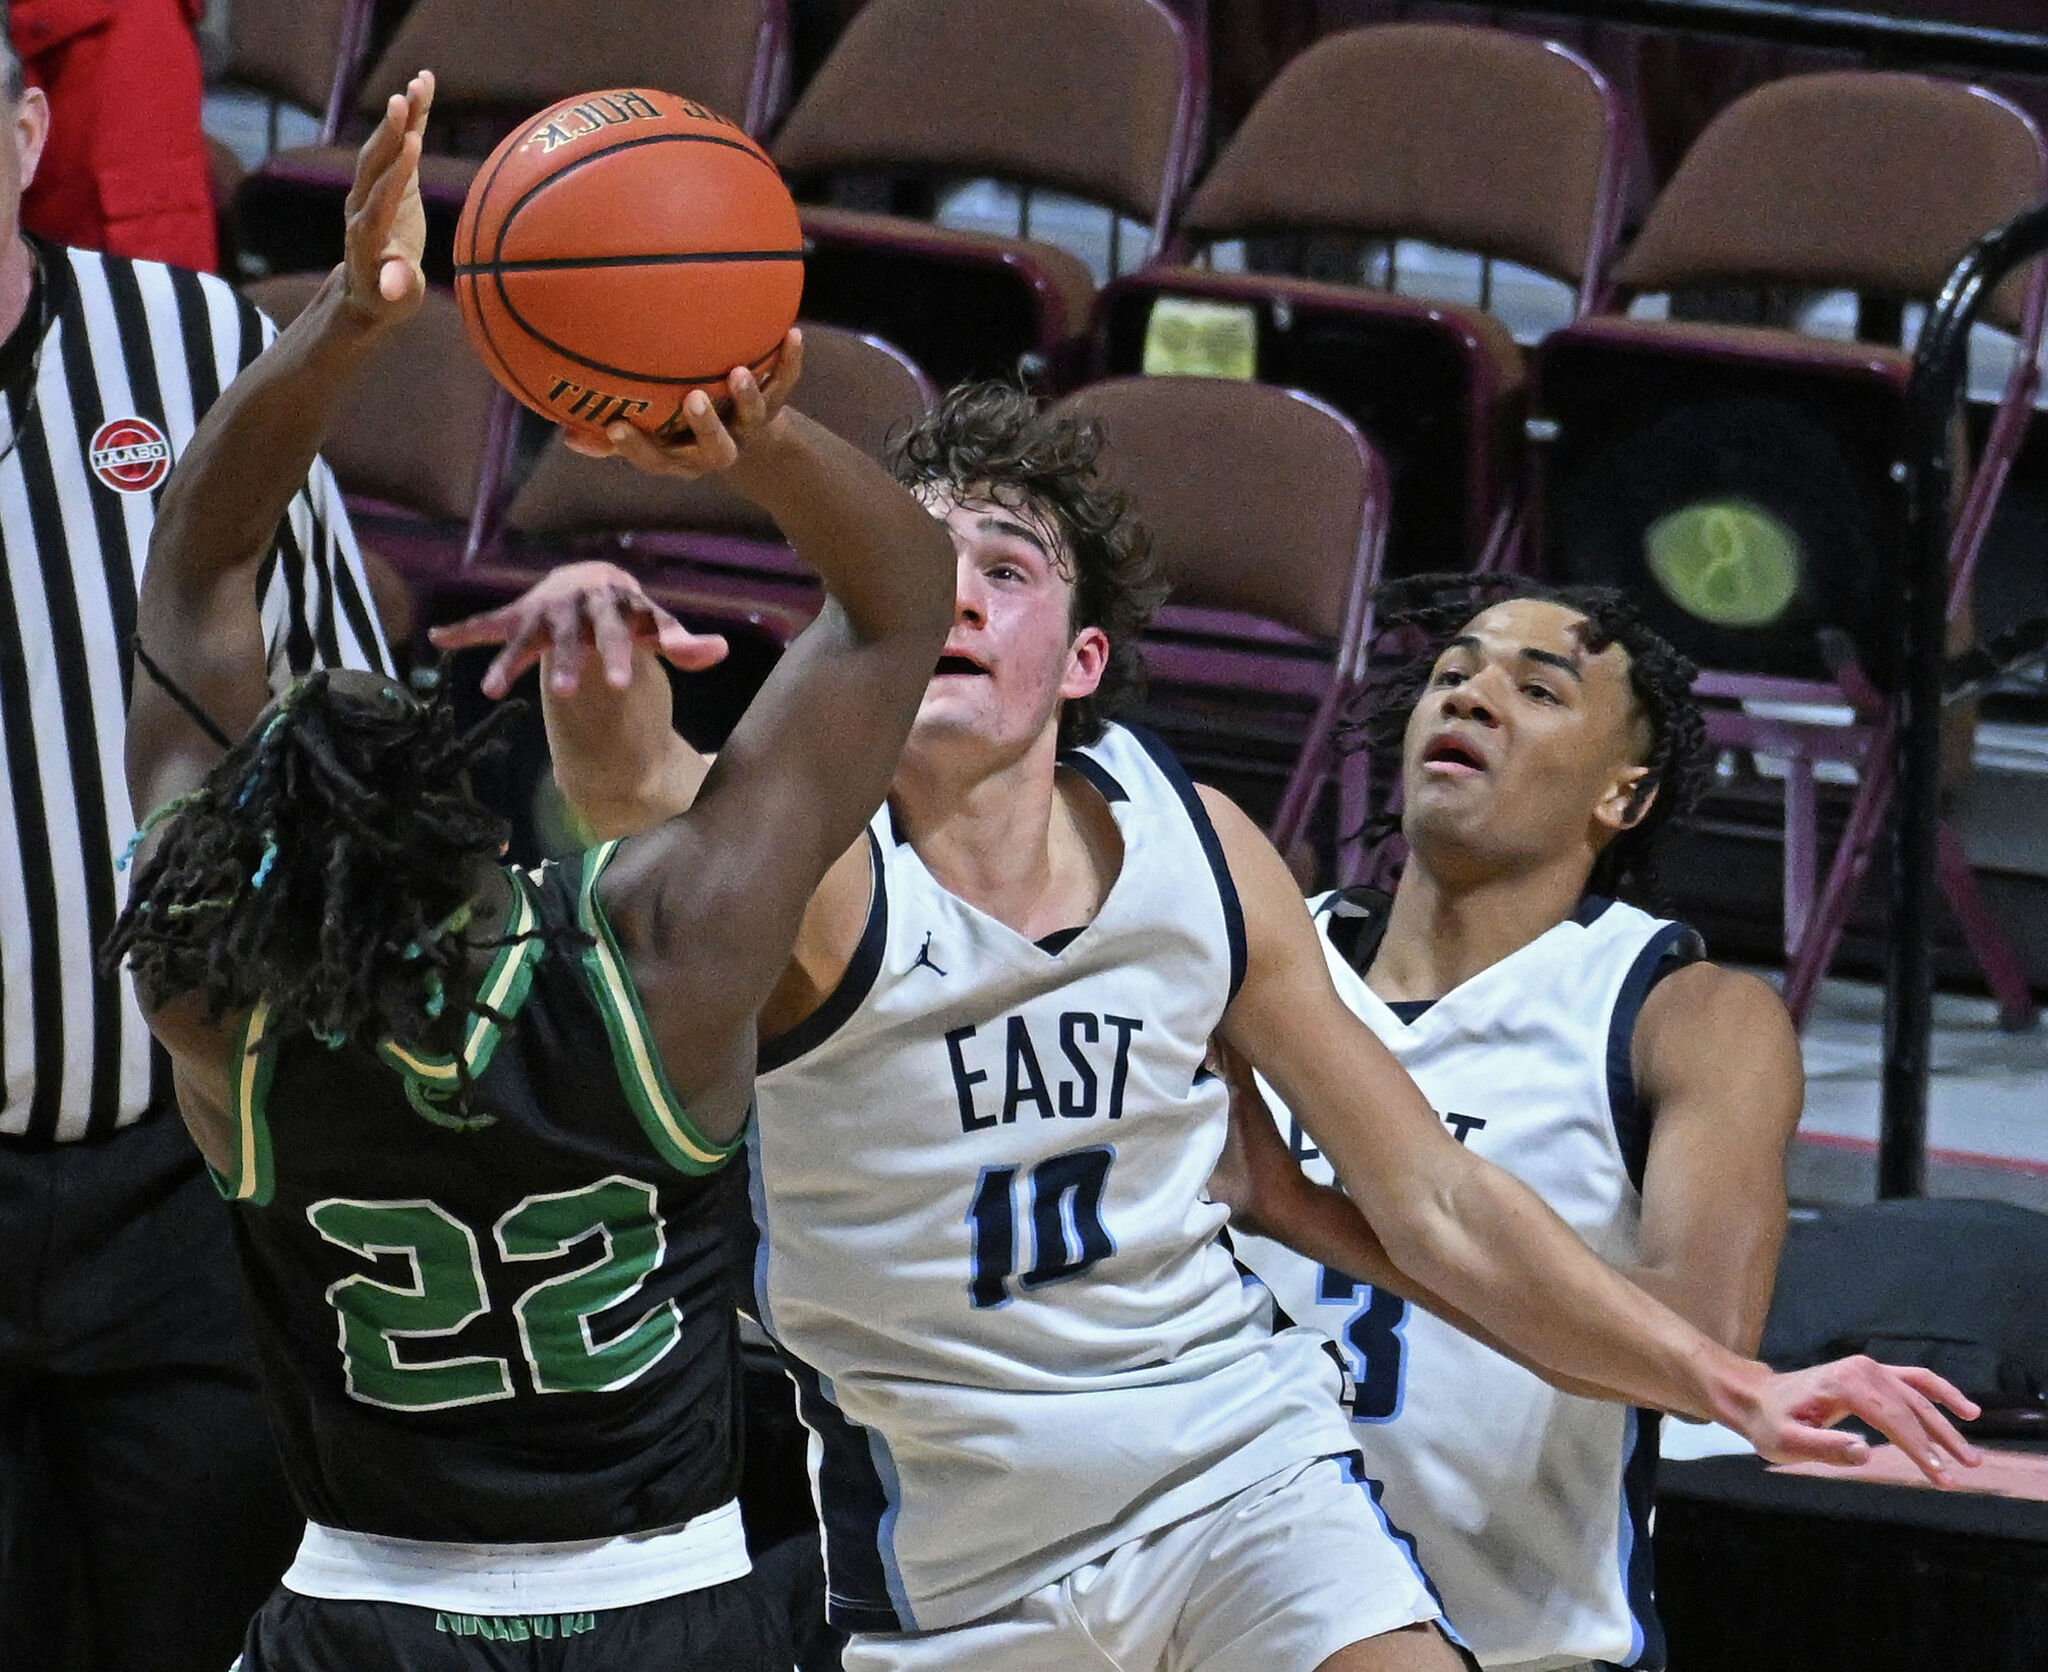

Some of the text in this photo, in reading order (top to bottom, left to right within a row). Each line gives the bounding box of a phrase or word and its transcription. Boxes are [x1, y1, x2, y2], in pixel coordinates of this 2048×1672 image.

[548, 374, 651, 428] THE
[944, 1012, 1144, 1133] EAST
[306, 1174, 684, 1412] 22
[964, 1143, 1118, 1310] 10
[1315, 1262, 1412, 1425] 3
